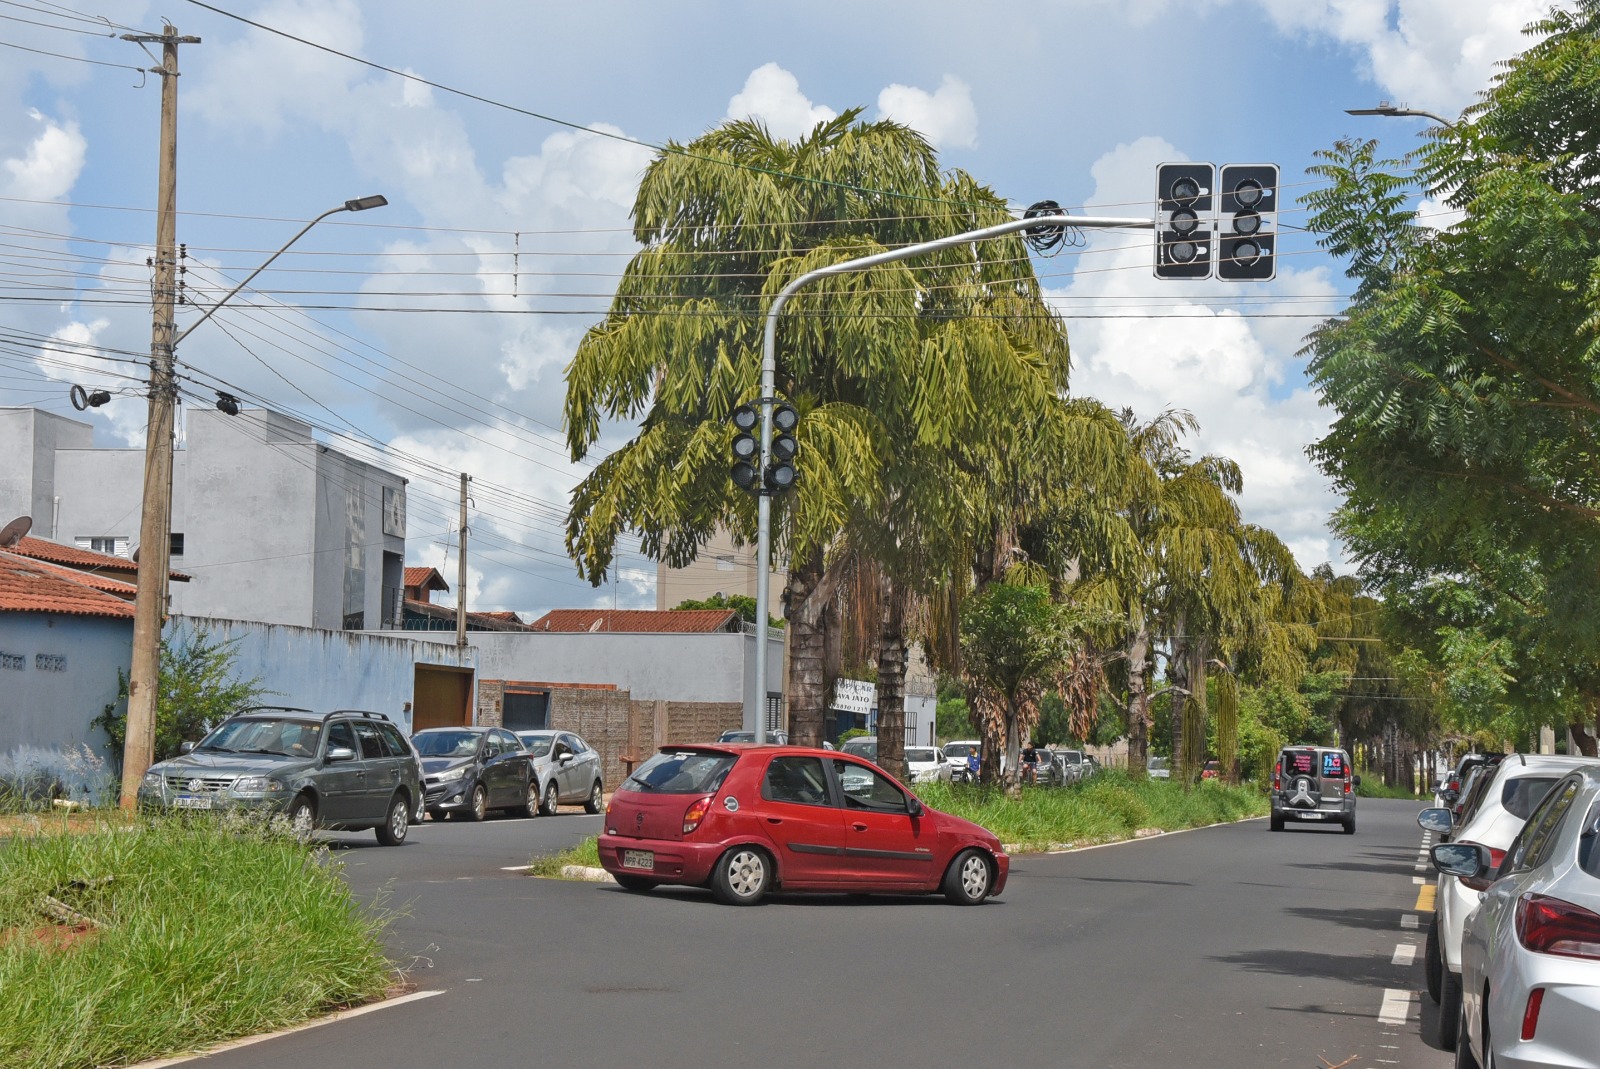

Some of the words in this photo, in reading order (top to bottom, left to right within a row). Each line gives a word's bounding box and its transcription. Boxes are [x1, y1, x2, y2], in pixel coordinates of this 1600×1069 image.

[837, 692, 850, 701] AVA
[852, 695, 870, 703] JATO
[1324, 755, 1341, 767] ha
